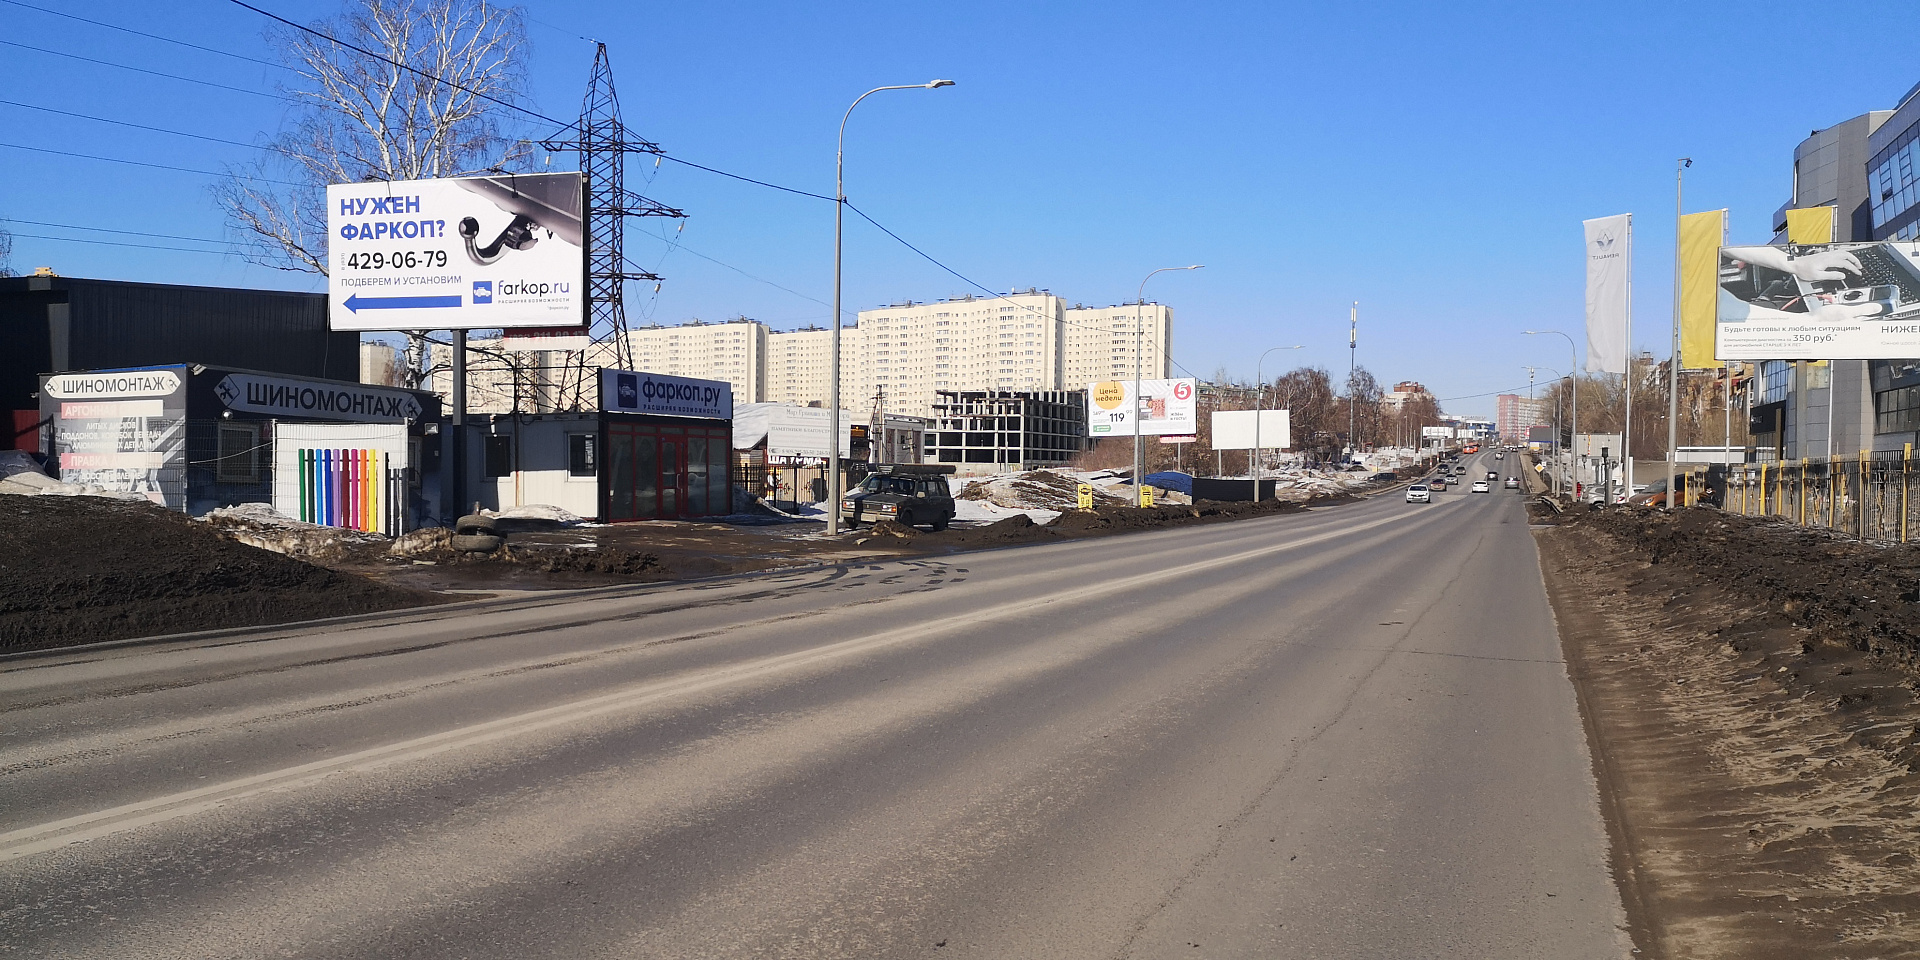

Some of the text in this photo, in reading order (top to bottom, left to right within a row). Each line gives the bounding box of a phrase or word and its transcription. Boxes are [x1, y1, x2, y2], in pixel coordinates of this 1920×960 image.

[340, 195, 420, 216] НУЖЕН
[340, 219, 445, 240] ФАРКОП?
[347, 250, 447, 269] 429-06-79
[341, 275, 462, 287] ПОДБЕРЕМ И УСТАНОВИМ
[498, 279, 570, 297] farkop.ru
[1724, 325, 1751, 333] Будьте
[1818, 325, 1861, 333] ситуациям
[1881, 325, 1920, 333] НИЖЕ
[1793, 334, 1811, 342] 350
[62, 376, 166, 394] ШИНОМОНТАЖ
[642, 376, 721, 407] фаркоп.ру
[246, 382, 404, 418] ШИНОМОНТАЖ
[678, 407, 721, 415] ВОЗМОЖНОСТИ
[1109, 412, 1125, 422] 119
[70, 455, 108, 467] ПРАВКА
[768, 456, 822, 465] ШАУРМА
